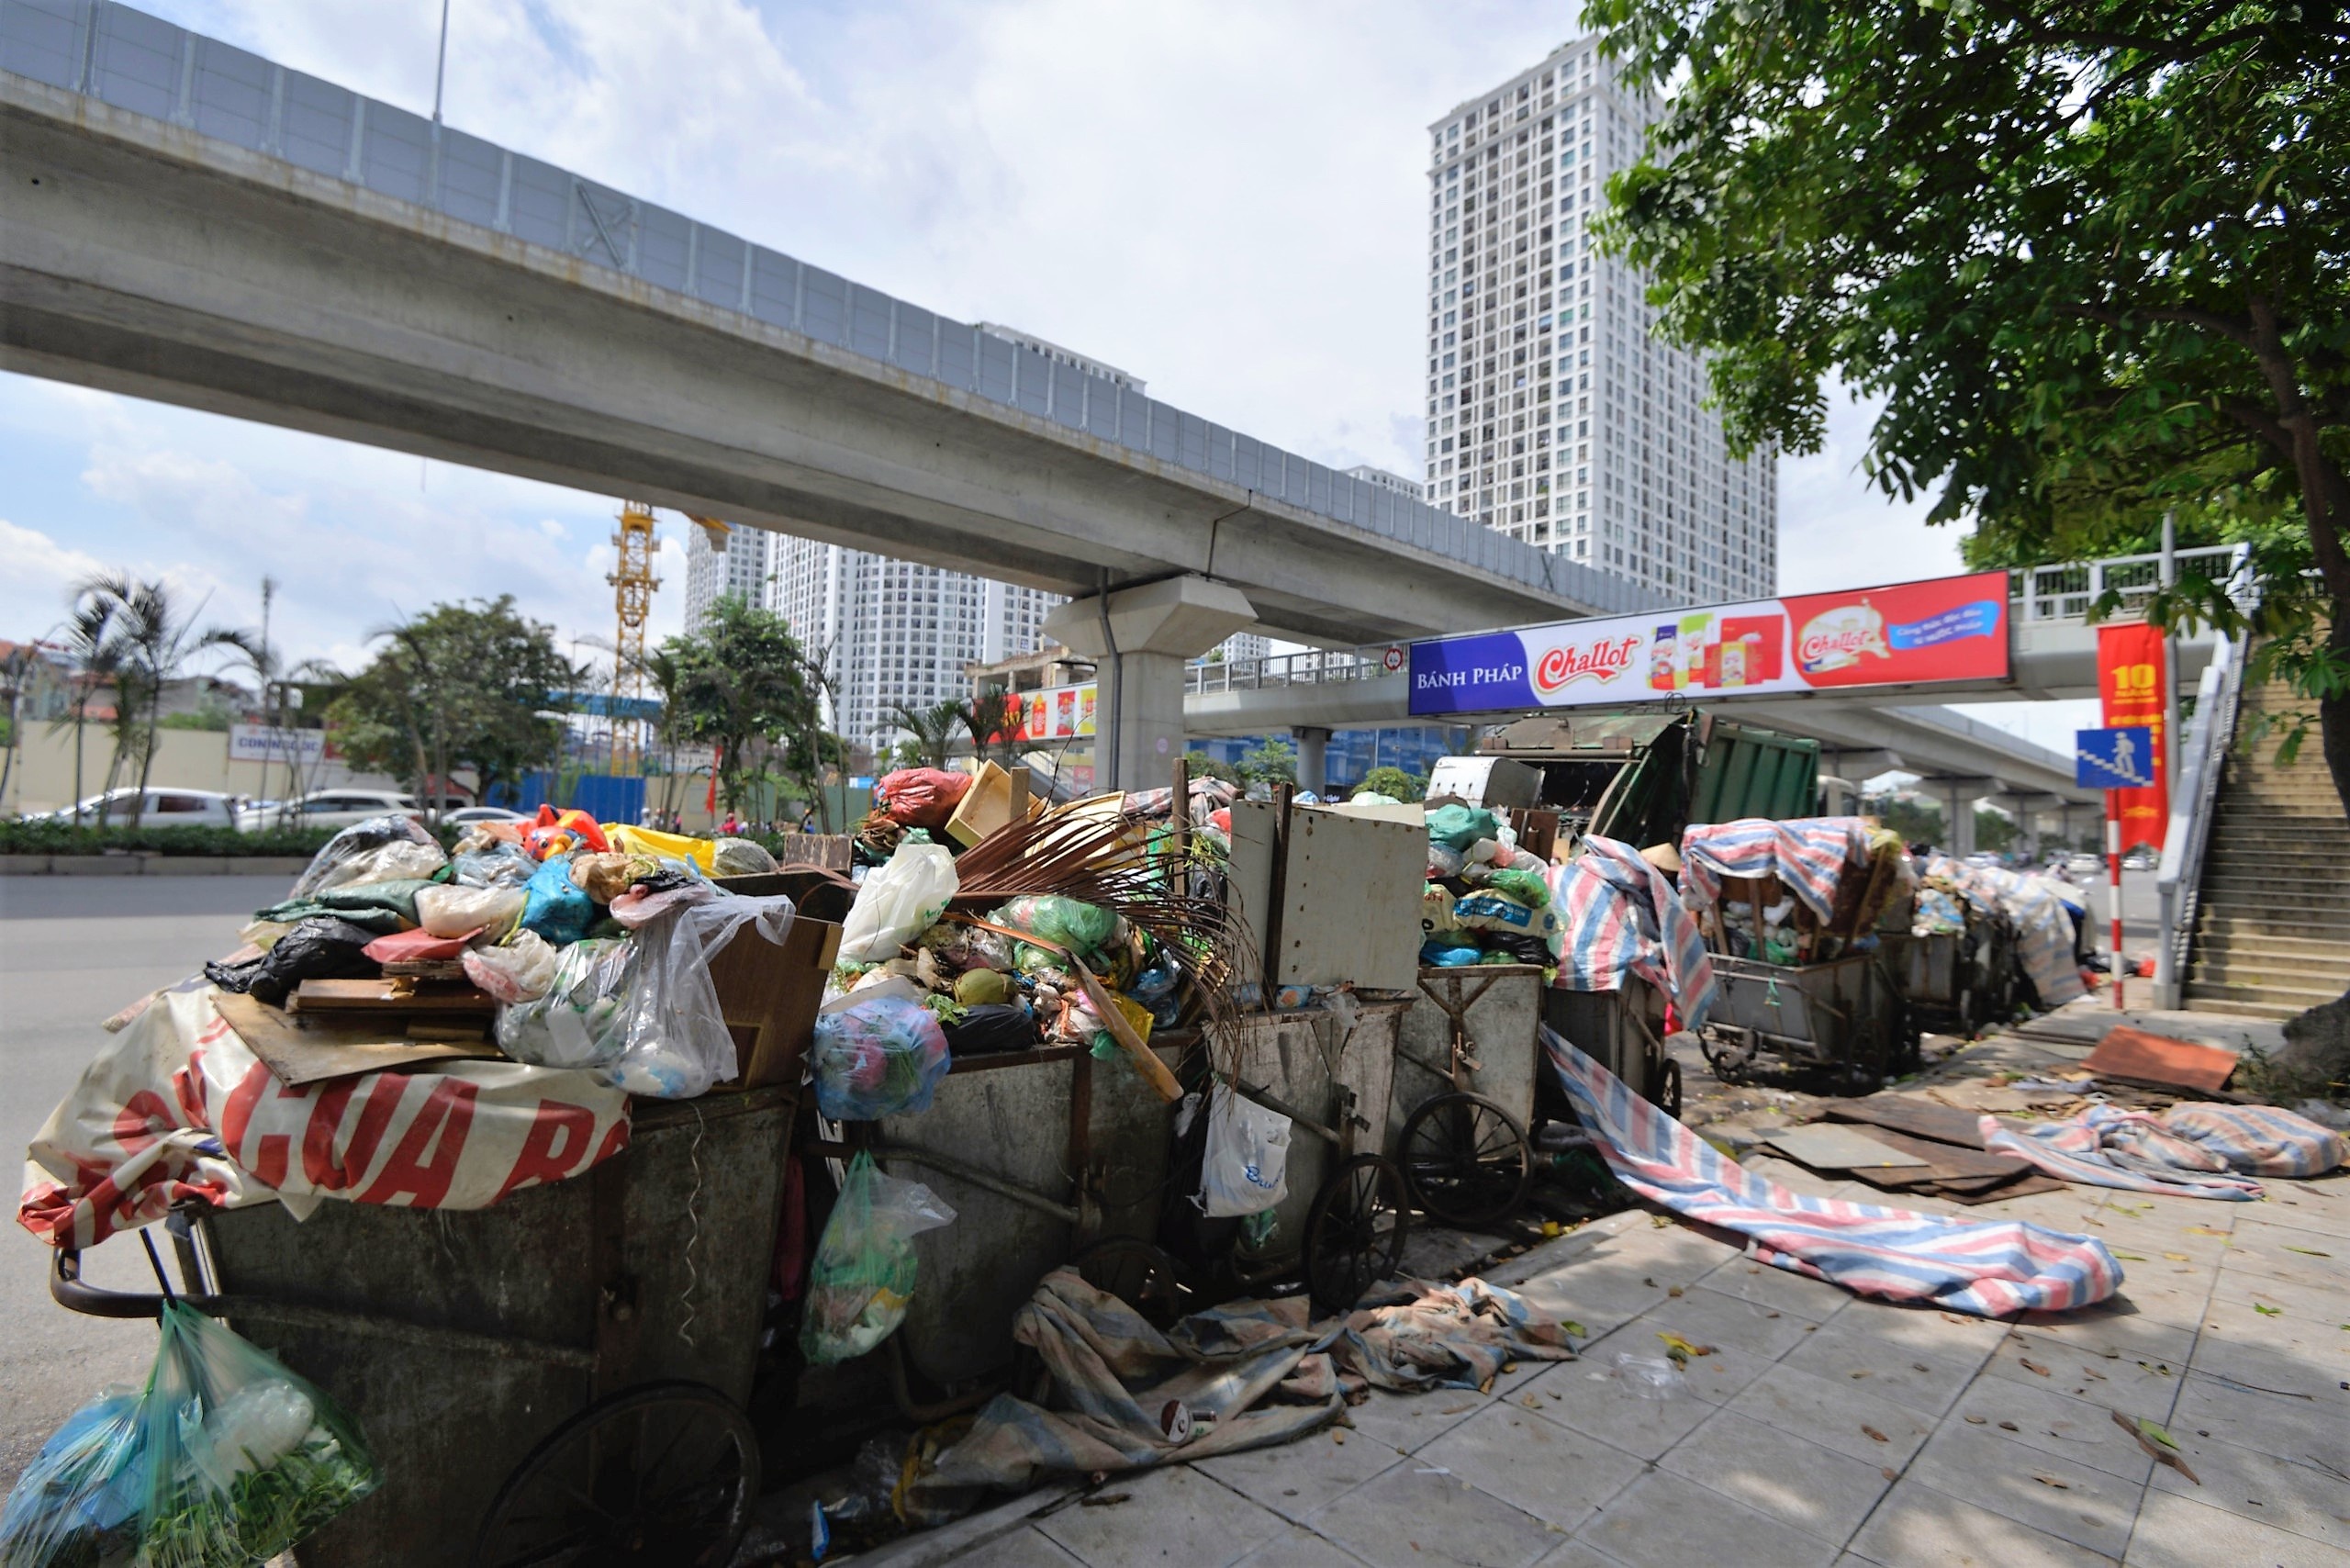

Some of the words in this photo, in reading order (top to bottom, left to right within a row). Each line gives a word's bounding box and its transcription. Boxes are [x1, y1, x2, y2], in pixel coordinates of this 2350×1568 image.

[1417, 670, 1467, 689] BÁNH
[1472, 663, 1523, 685] PHÁP
[1538, 637, 1639, 689] Challot
[2111, 664, 2156, 689] 10
